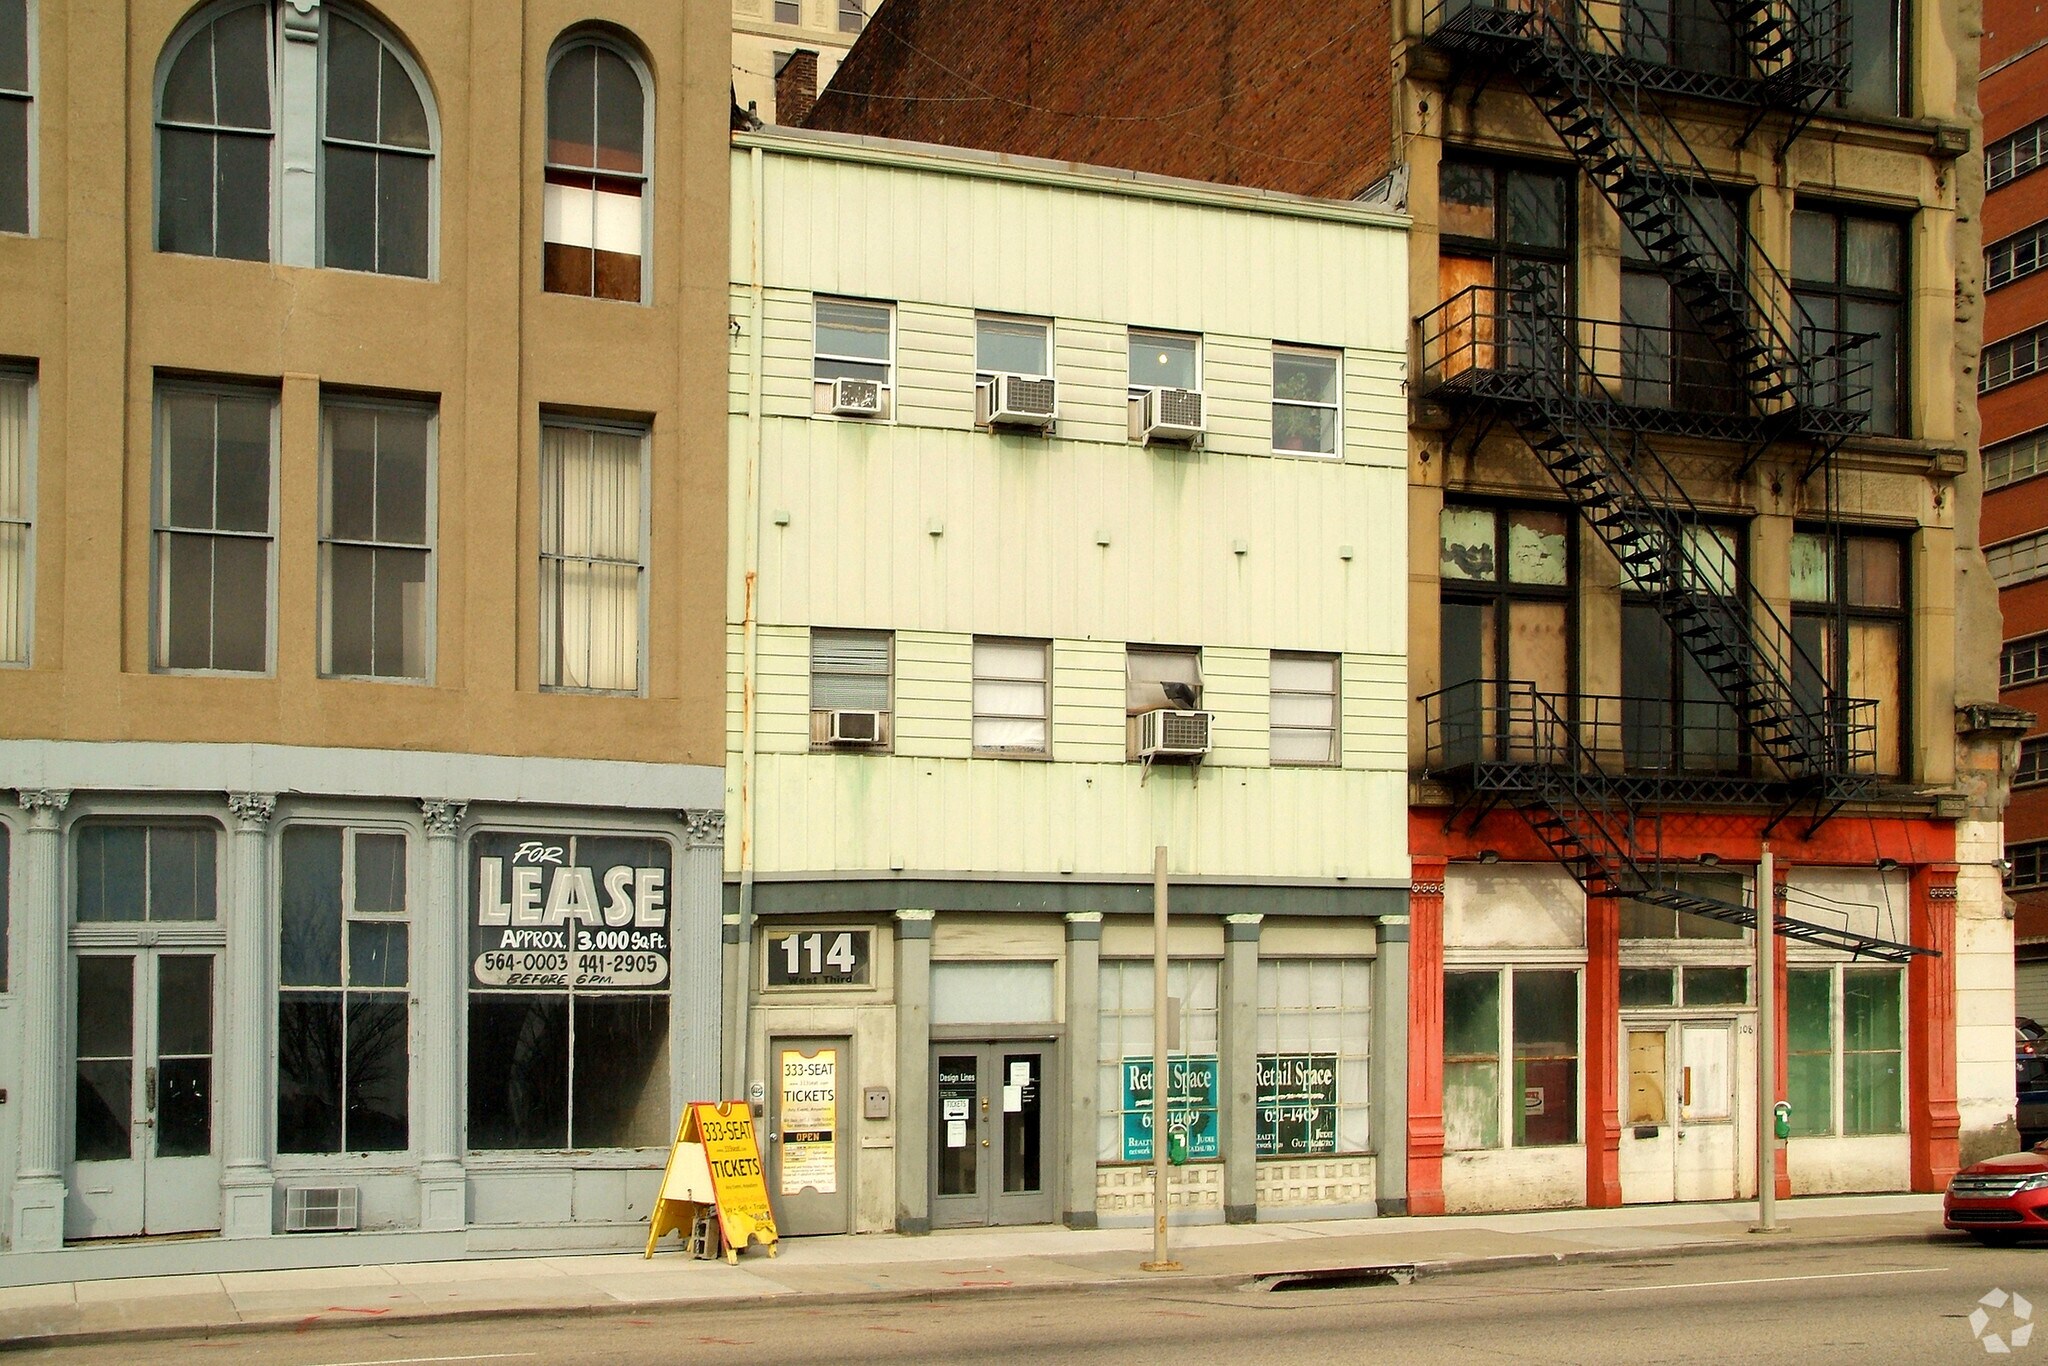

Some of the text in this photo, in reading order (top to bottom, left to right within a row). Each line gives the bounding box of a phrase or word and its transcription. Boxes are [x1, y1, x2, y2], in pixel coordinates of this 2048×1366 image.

[512, 841, 564, 864] FOR
[478, 856, 666, 927] LEASE
[577, 930, 630, 951] 3,000
[485, 953, 658, 974] 564-0003 441-2905
[781, 933, 855, 974] 114
[506, 973, 568, 985] BEFORE
[788, 975, 852, 985] West Third
[785, 1063, 834, 1077] 333-SEAT
[940, 1073, 975, 1084] Design Lines
[1129, 1064, 1212, 1095] Retl Space
[1295, 1061, 1333, 1092] Space
[783, 1089, 835, 1102] TICKETS
[703, 1120, 752, 1141] 333-SEAT
[796, 1133, 820, 1142] OPEN
[711, 1158, 760, 1178] TICKETS
